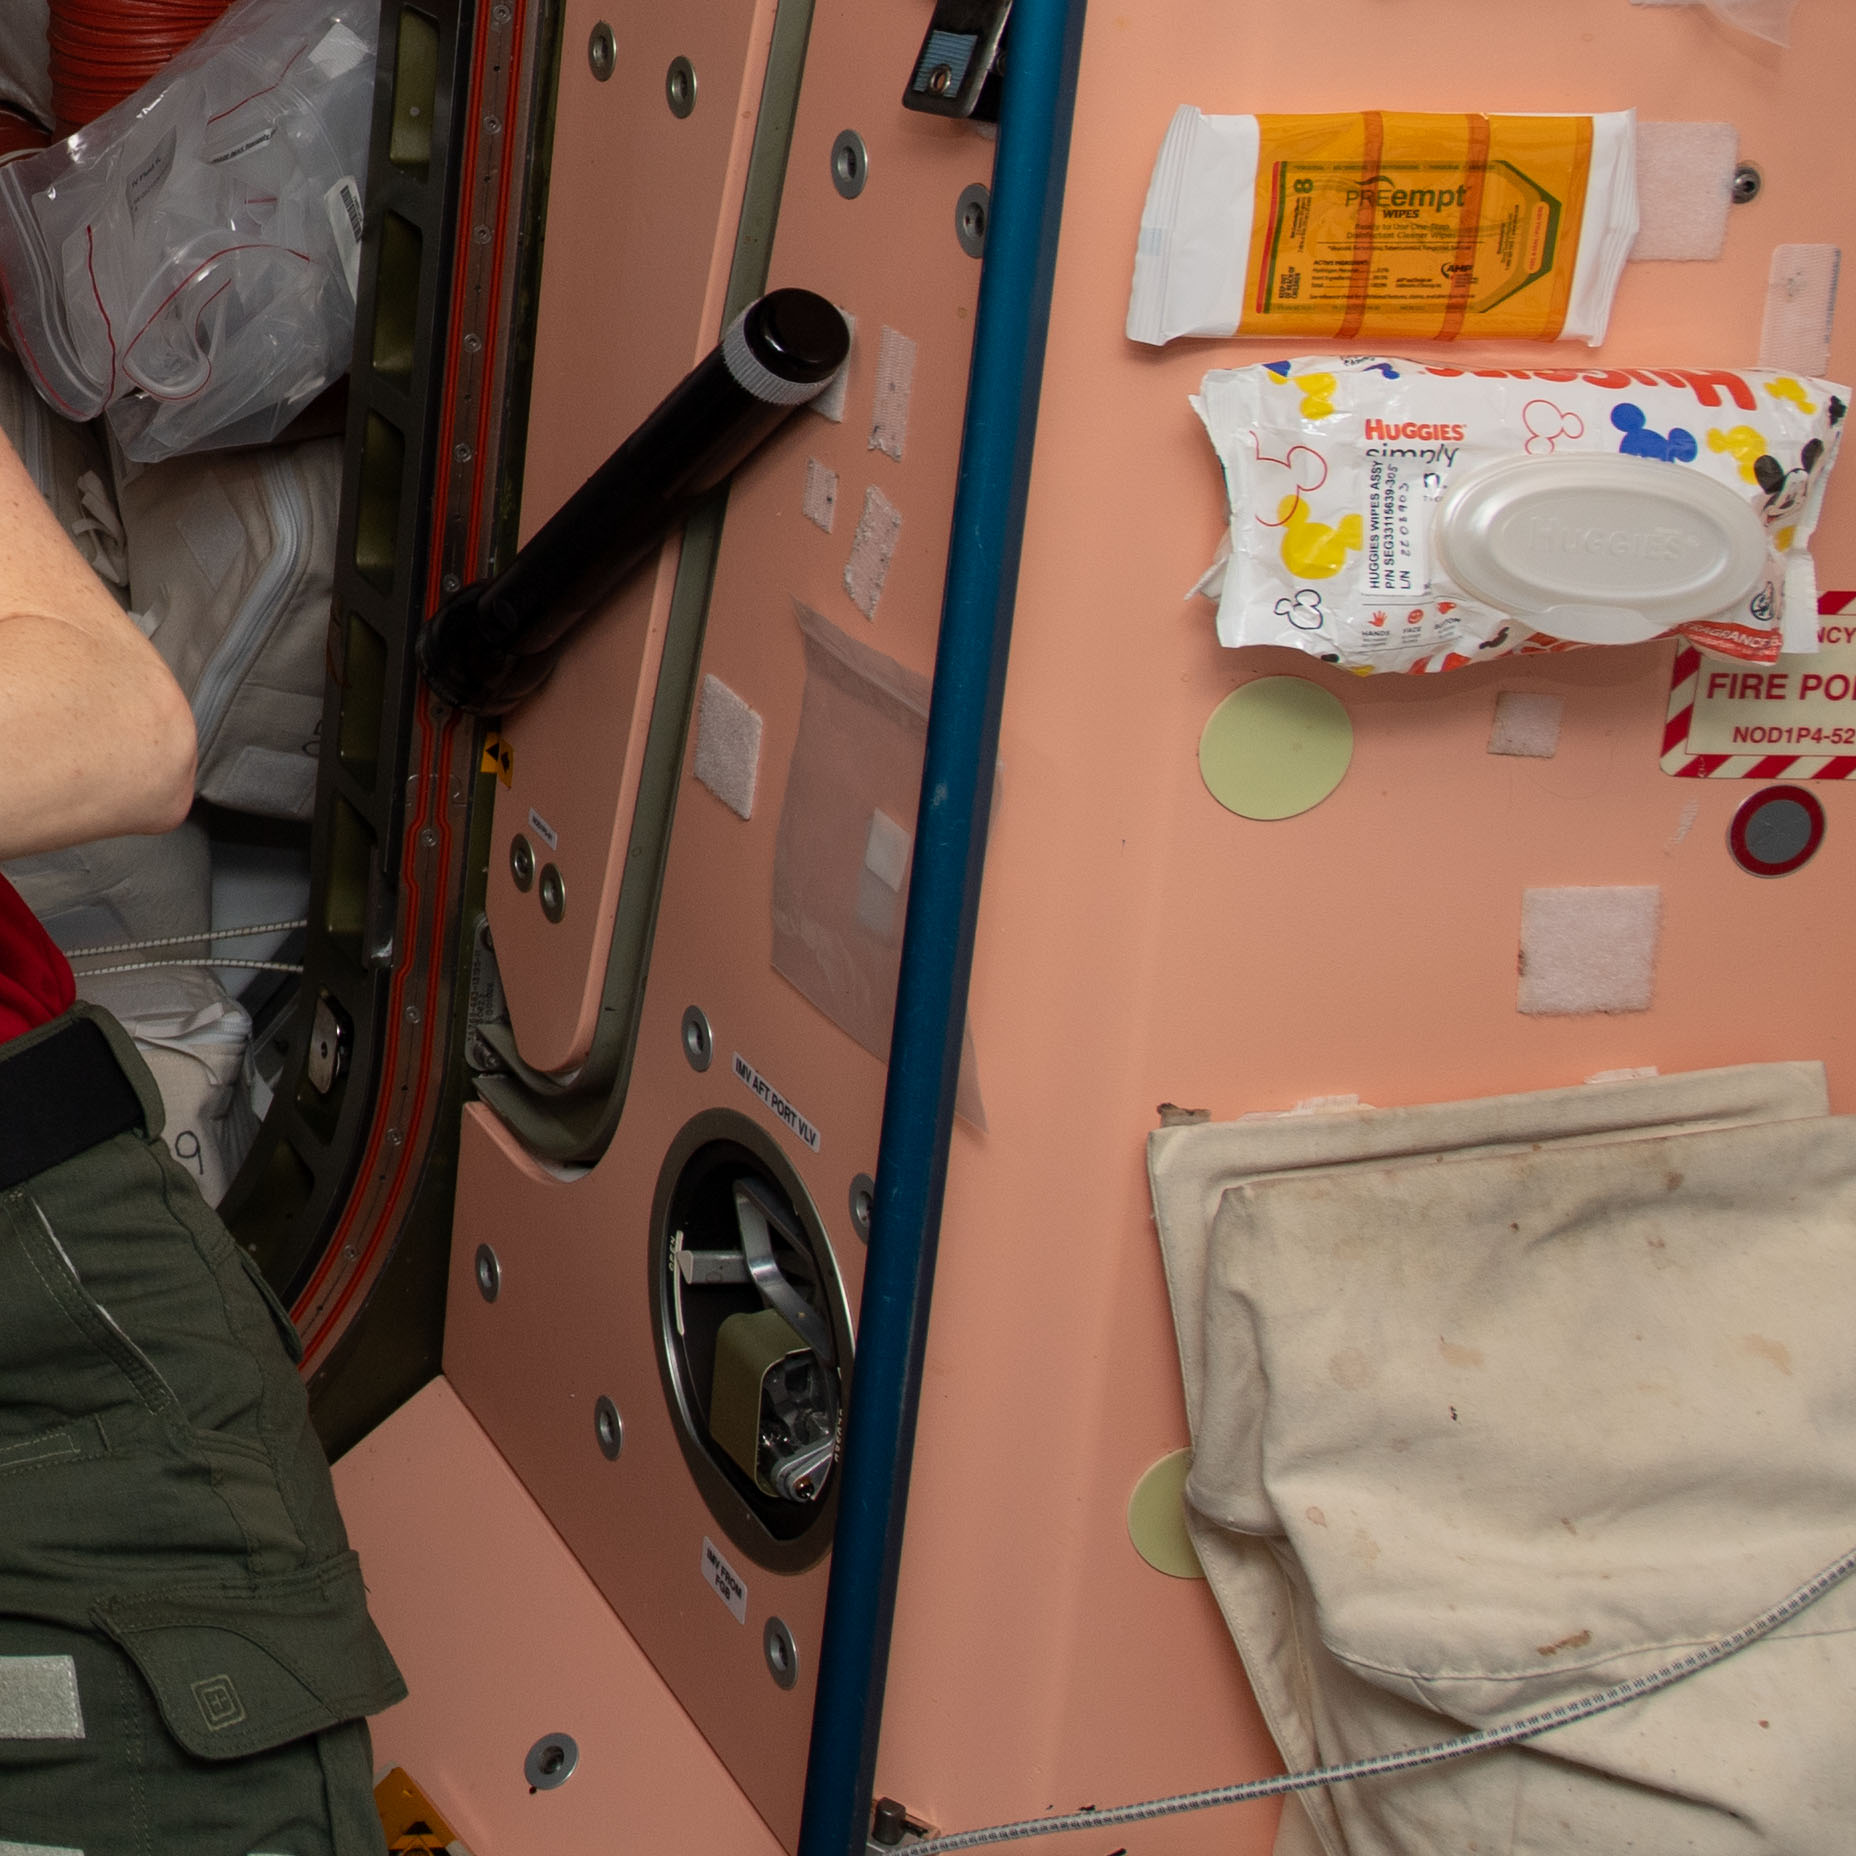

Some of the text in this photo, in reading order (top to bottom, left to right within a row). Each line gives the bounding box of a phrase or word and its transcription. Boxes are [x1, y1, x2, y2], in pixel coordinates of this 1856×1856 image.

[1345, 183, 1467, 213] PREempt
[1382, 209, 1420, 219] WIPES
[1365, 418, 1465, 442] HUGGIES
[1369, 461, 1383, 589] HUGGIES WIPES ASSY
[1386, 570, 1396, 590] P/N
[1400, 570, 1411, 590] L/N
[1361, 629, 1390, 637] HANDS
[1705, 672, 1788, 701] FIRE
[1732, 725, 1855, 745] NOD1P4-52
[736, 1058, 816, 1146] IMV AFT PORT VLV
[720, 1566, 742, 1600] FROM
